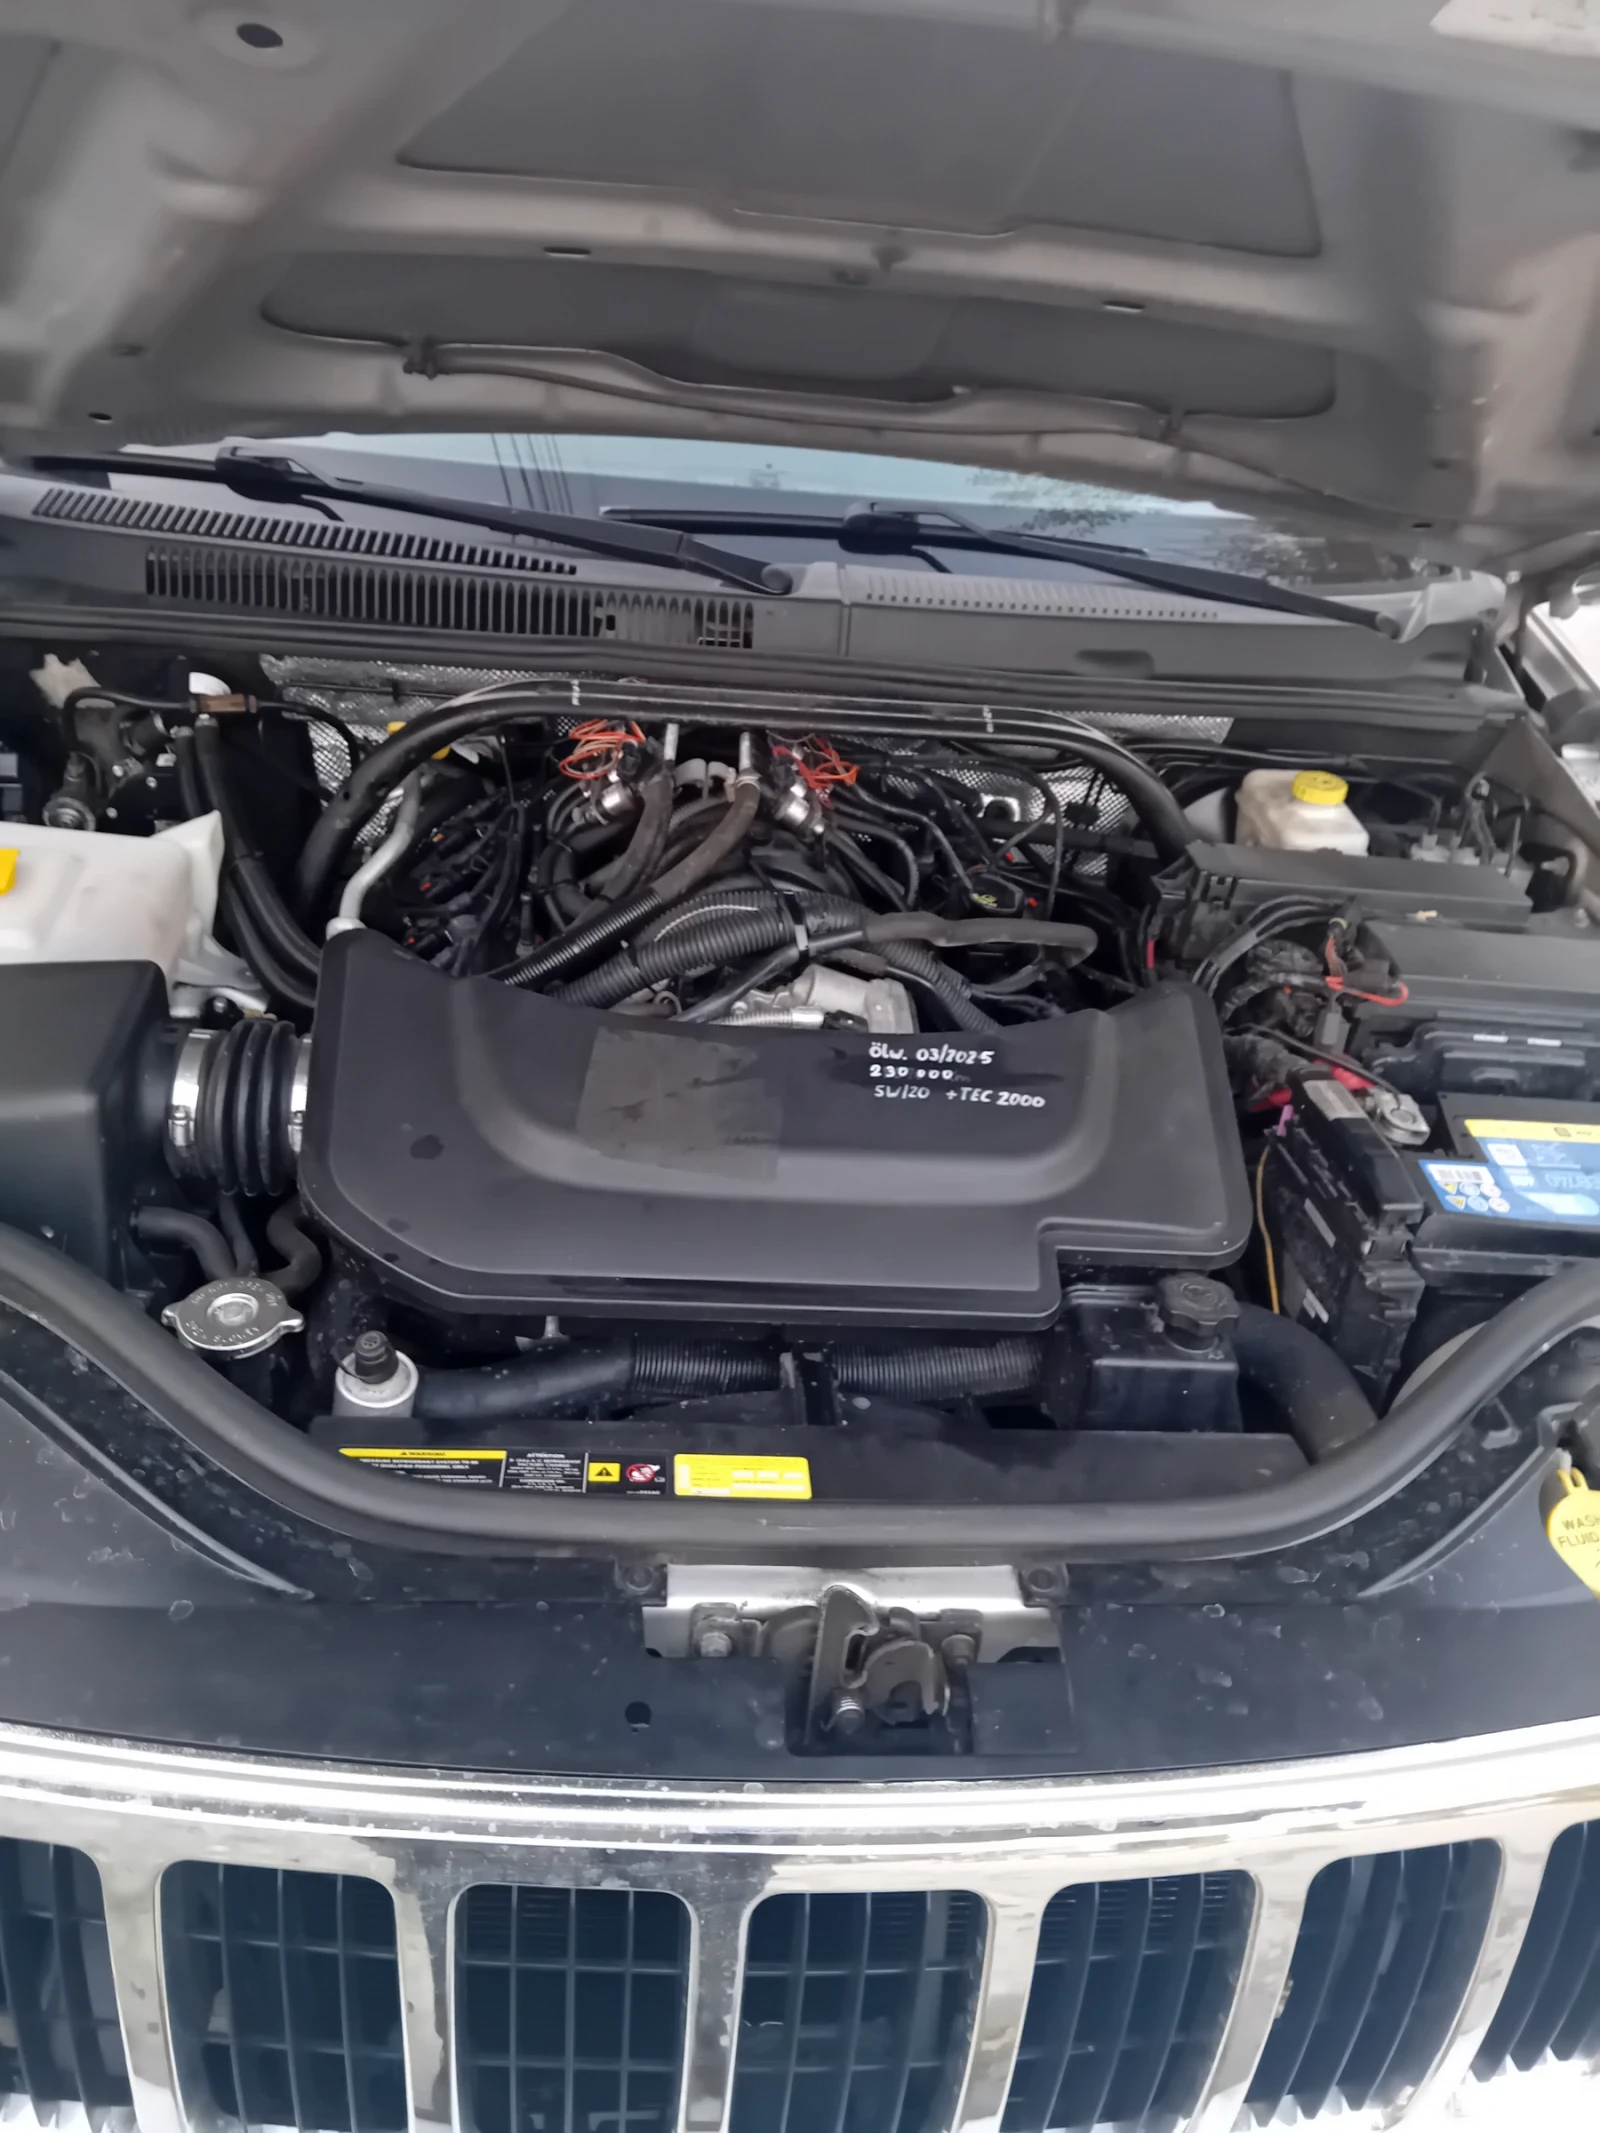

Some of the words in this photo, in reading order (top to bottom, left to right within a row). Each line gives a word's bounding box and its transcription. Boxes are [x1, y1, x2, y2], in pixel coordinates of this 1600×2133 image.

[915, 1043, 996, 1065] 03/2025
[869, 1064, 909, 1078] 230
[996, 1091, 1046, 1108] 2000
[1557, 1532, 1600, 1549] FLUID
